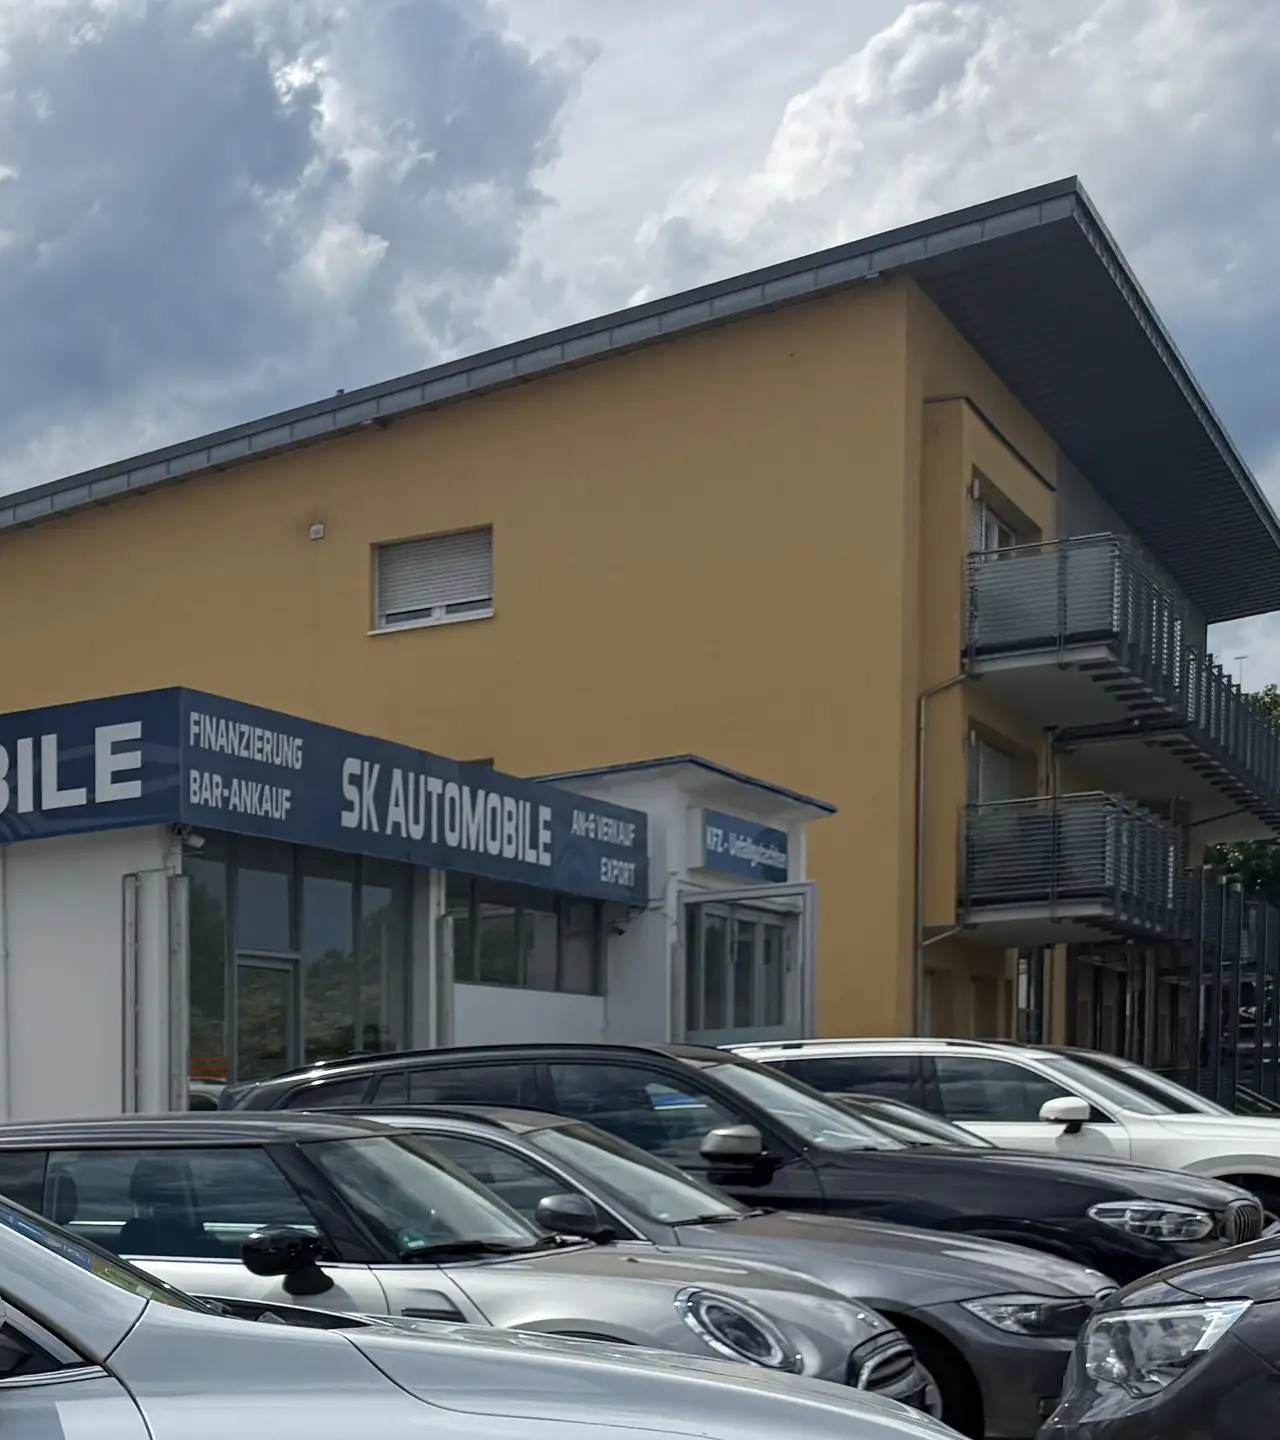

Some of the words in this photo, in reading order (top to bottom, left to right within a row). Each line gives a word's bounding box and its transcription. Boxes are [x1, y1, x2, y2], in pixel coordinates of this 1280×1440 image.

[190, 711, 304, 770] FINANZIERUNG
[190, 769, 292, 820] BAR-ANKAUF
[341, 757, 380, 833] SK
[385, 768, 552, 867] AUTOMOBILE
[596, 814, 635, 847] VERKAUF
[706, 825, 723, 853] KFZ
[600, 856, 636, 887] EXPORT
